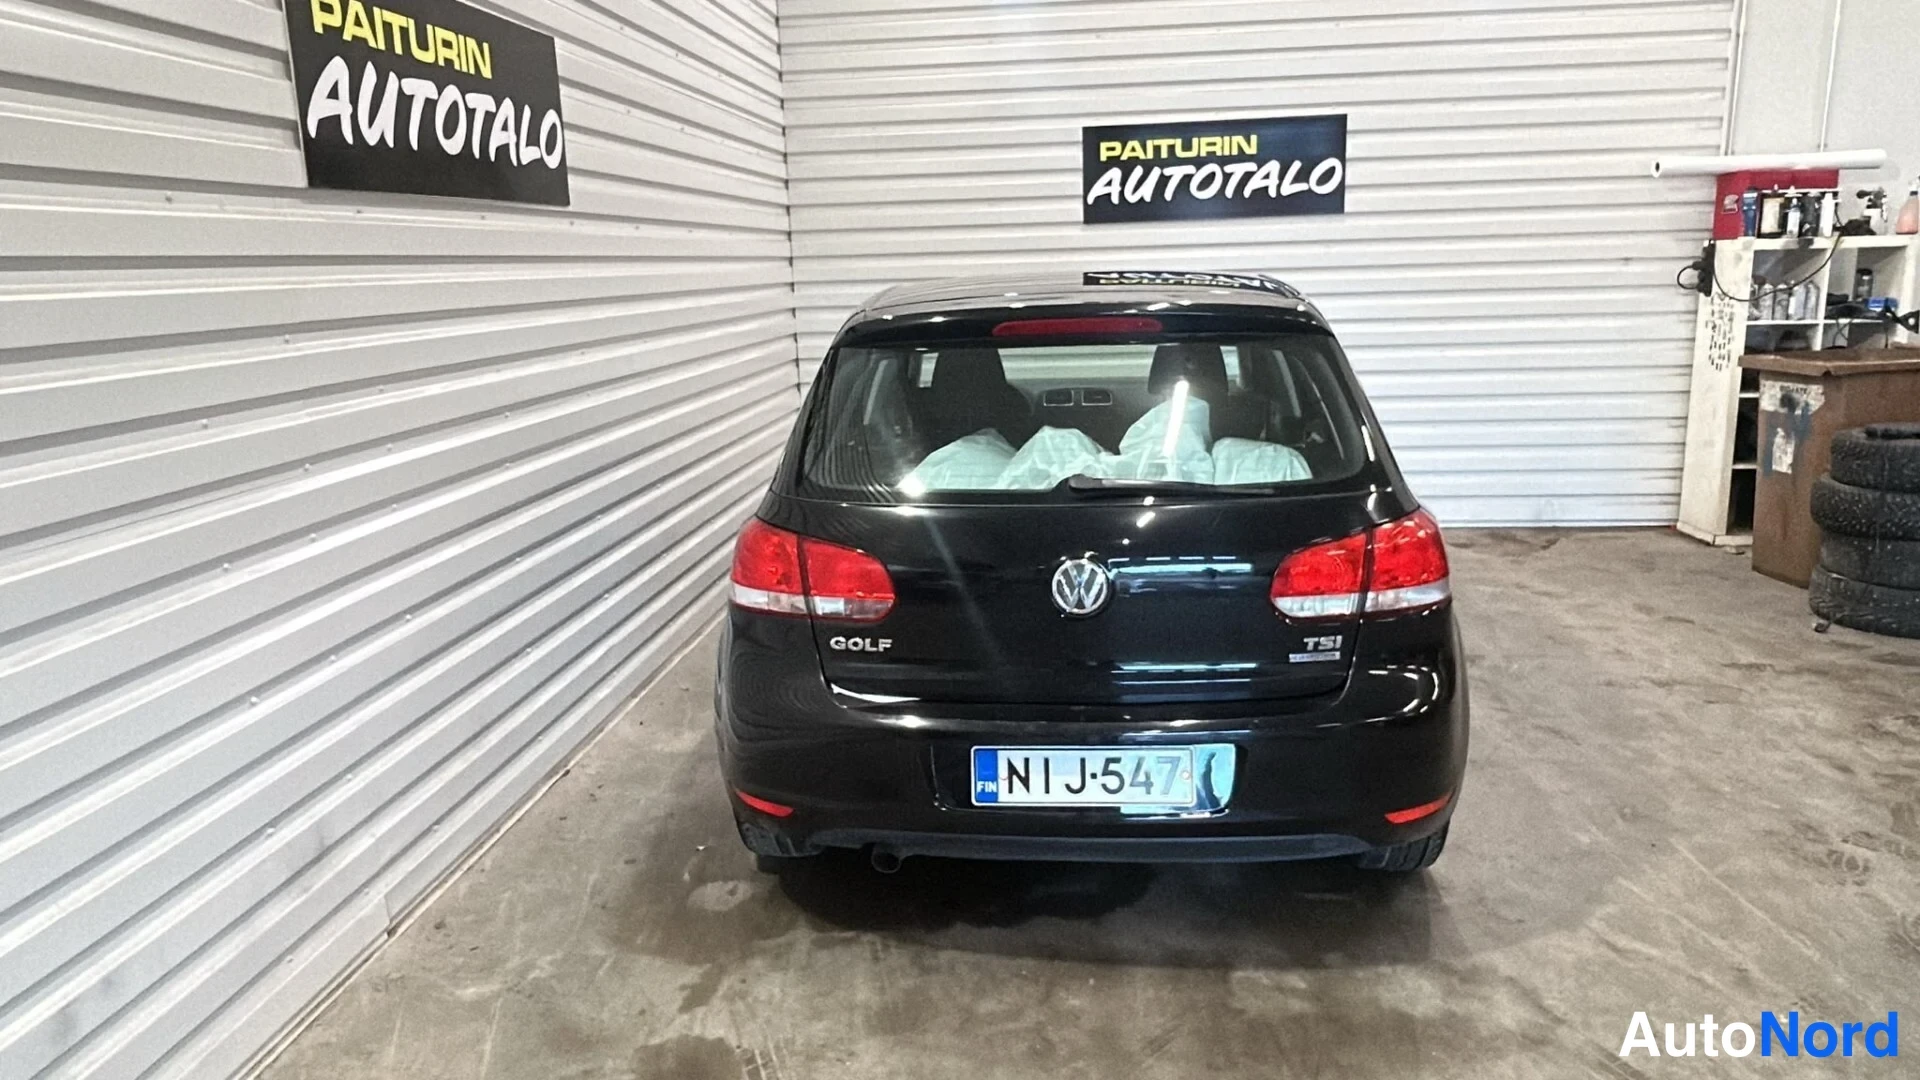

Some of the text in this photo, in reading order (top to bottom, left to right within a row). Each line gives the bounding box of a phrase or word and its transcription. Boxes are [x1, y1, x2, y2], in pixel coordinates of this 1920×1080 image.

[311, 0, 492, 79] PAITURIN
[307, 55, 562, 169] AUTOTALO
[1100, 135, 1258, 162] PAITURIN
[1086, 157, 1343, 205] AUTOTALO
[829, 636, 893, 652] GOLF
[1303, 635, 1343, 651] TSI
[976, 780, 998, 793] FIN
[1007, 756, 1182, 796] NIJ-547
